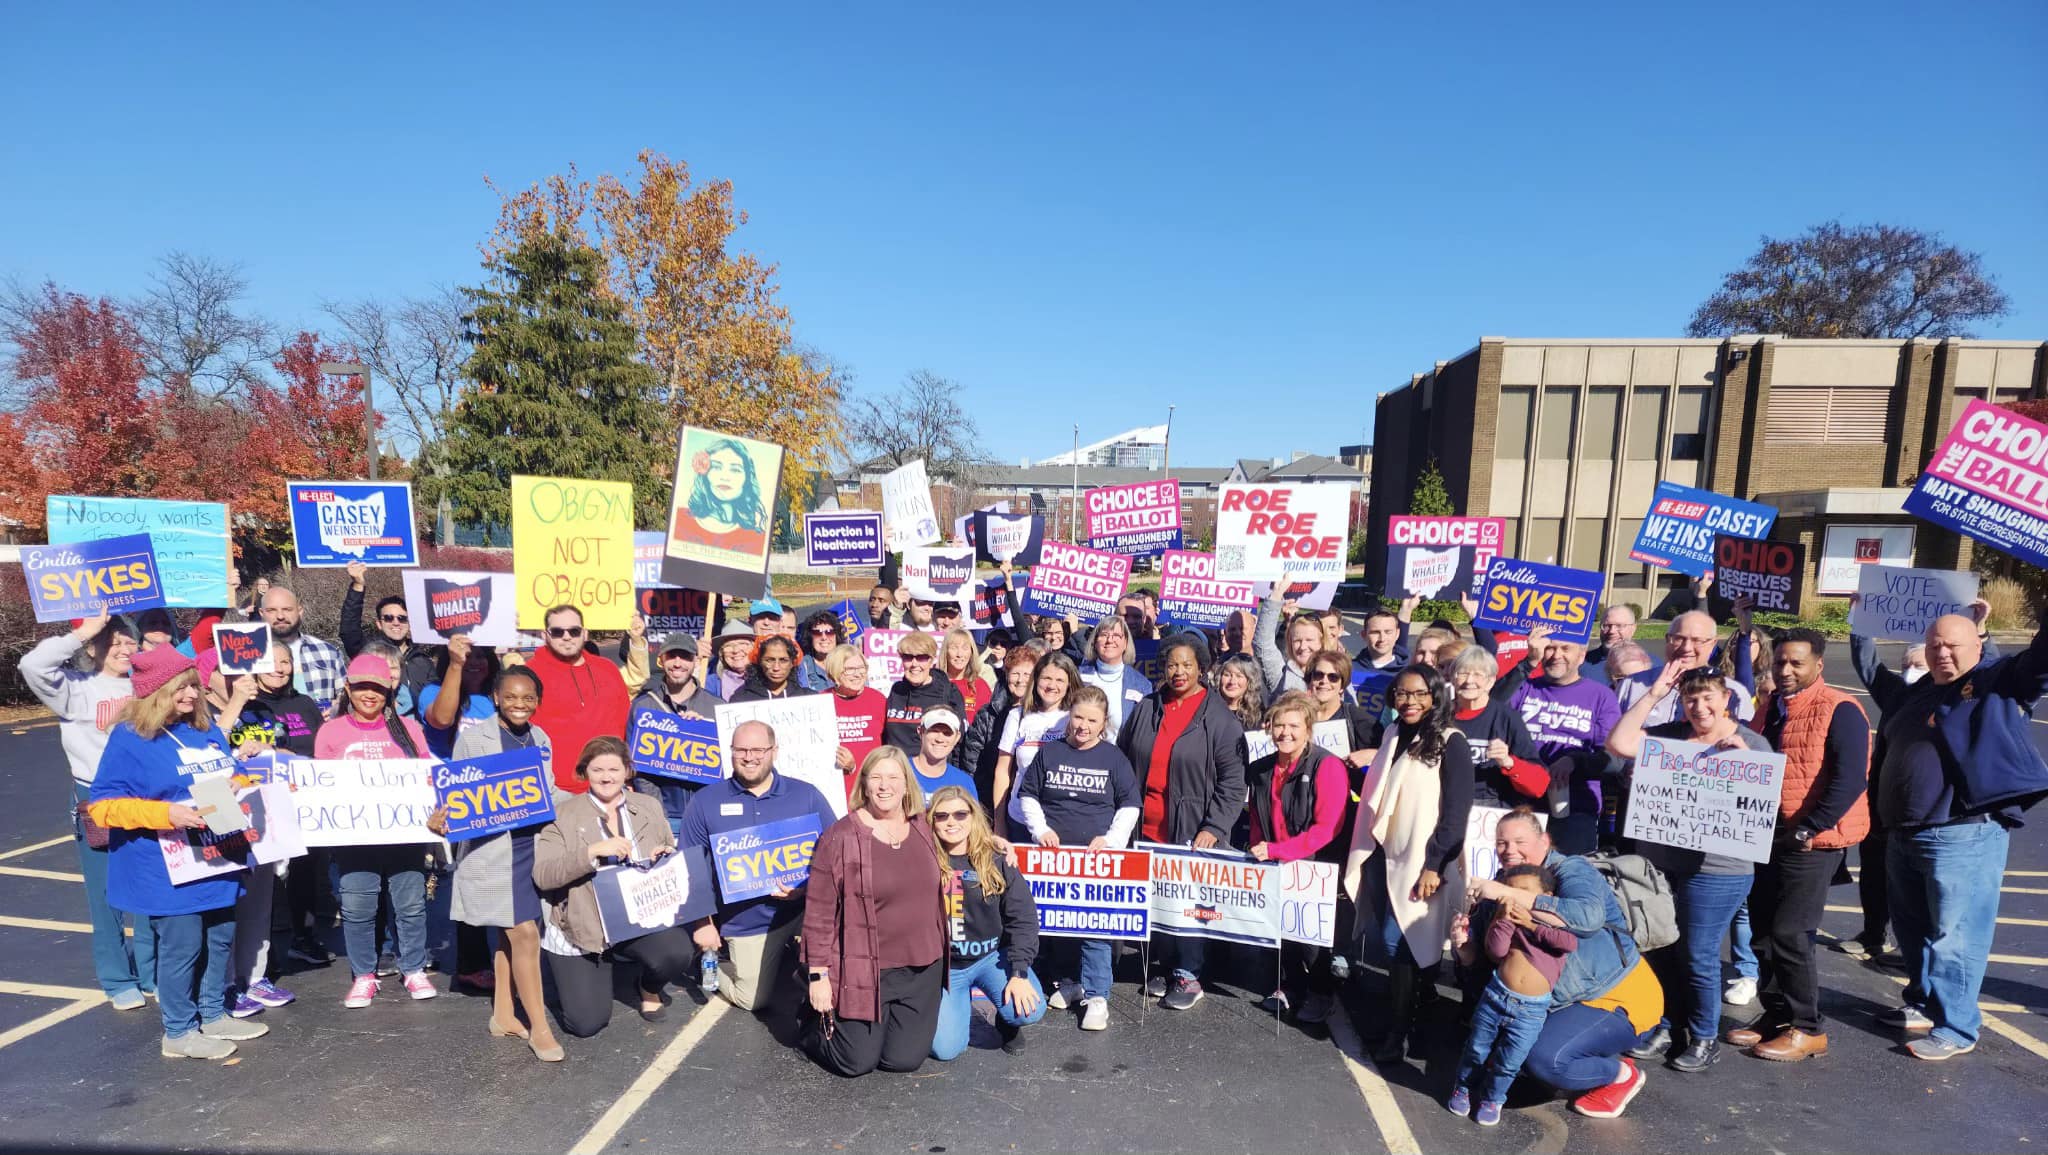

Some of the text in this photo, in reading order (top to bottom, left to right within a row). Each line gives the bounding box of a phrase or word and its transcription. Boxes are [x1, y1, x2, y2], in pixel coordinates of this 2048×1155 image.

[1963, 410, 2048, 467] CHOI
[1936, 442, 1969, 474] THE
[1964, 456, 2048, 510] BALL
[530, 481, 633, 523] OB/GYN
[1090, 486, 1158, 512] CHOICE
[1221, 489, 1292, 512] ROE
[1922, 477, 1969, 505] MATT
[1965, 494, 2048, 541] SHAUGHNE
[66, 501, 213, 531] Nobody wants
[322, 505, 380, 525] CASEY
[1105, 510, 1172, 531] BALLOT
[1246, 513, 1317, 535] ROE
[1658, 501, 1769, 538] RE-ELECT CASEY
[1931, 500, 1950, 515] FOR
[1950, 508, 1978, 527] STATE
[324, 525, 380, 536] WEINSTEIN
[814, 525, 875, 538] Abortion is
[1091, 515, 1100, 536] THE
[1394, 521, 1479, 544] CHOICE
[814, 539, 876, 551] Healthcare
[992, 533, 1022, 545] WHALEY
[1093, 530, 1177, 548] MATT SHAUGHNESSY
[1270, 536, 1343, 559] ROE
[28, 551, 86, 570] Emilia
[553, 537, 611, 566] NOT
[1040, 544, 1110, 576] CHOICE
[1640, 538, 1667, 551] STATE
[1668, 545, 1714, 564] REPRESEN
[1719, 539, 1794, 575] OHIO
[905, 564, 970, 581] Nan Whaley
[1034, 566, 1045, 586] THE
[1168, 555, 1215, 578] CHOI
[1283, 561, 1341, 572] YOUR VOTE!
[1412, 564, 1448, 577] WHALEY
[1489, 561, 1538, 584] Emilia
[40, 562, 151, 600] SYKES
[532, 573, 632, 607] OB/GOP
[1048, 572, 1118, 598] BALLOT
[1164, 577, 1175, 596] THE
[1719, 567, 1791, 591] DESERVES
[1885, 571, 1937, 597] VOTE
[432, 586, 480, 604] WOMEN FOR
[1031, 589, 1116, 615] MATT SHAUGHNESSY
[1179, 581, 1251, 601] BALLOT
[67, 595, 136, 611] FOR CONGRESS
[433, 597, 480, 617] WHALEY
[1162, 600, 1186, 612] MATT
[1487, 584, 1588, 624] SYKES
[1863, 592, 1900, 614] PRO
[435, 612, 481, 630] STEPHENS
[644, 615, 704, 628] DESERVE
[1502, 616, 1518, 626] FOR
[222, 632, 253, 651] Nan
[233, 647, 262, 664] Fan
[638, 712, 680, 733] Emilia
[1521, 703, 1591, 732] Zayas
[1549, 702, 1592, 720] Marilyn
[838, 721, 868, 730] MAND
[638, 732, 720, 768] SYKES
[650, 760, 702, 776] FOR CONGRESS
[1059, 764, 1077, 773] RITA
[1641, 739, 1773, 786] PRO-CHOICE
[291, 762, 335, 787] We
[436, 765, 486, 788] Emilia
[1672, 773, 1735, 794] BECAUSE
[447, 776, 542, 819] SYKES
[1636, 783, 1776, 814] WOMEN HAVE
[298, 804, 368, 831] BACK
[470, 809, 529, 829] FOR CONGRESS
[1636, 799, 1774, 830] MORE RIGHTS THAN
[1632, 812, 1758, 845] A NON-VIABLE
[1634, 825, 1703, 849] FETUS!!
[716, 835, 763, 855] Emilia
[726, 841, 815, 882] SYKES
[1027, 850, 1125, 877] PROTECT
[766, 871, 805, 887] CONGRESS
[1152, 857, 1266, 891] NAN WHALEY
[633, 876, 677, 906] WHALEY
[1026, 880, 1146, 903] MEN'S RIGHTS
[1200, 886, 1266, 909] STEPHENS
[637, 891, 682, 920] STEPHENS
[1185, 910, 1221, 920] FOR OHIO
[1045, 909, 1143, 931] DEMOCRATIC
[1282, 900, 1333, 941] OICE
